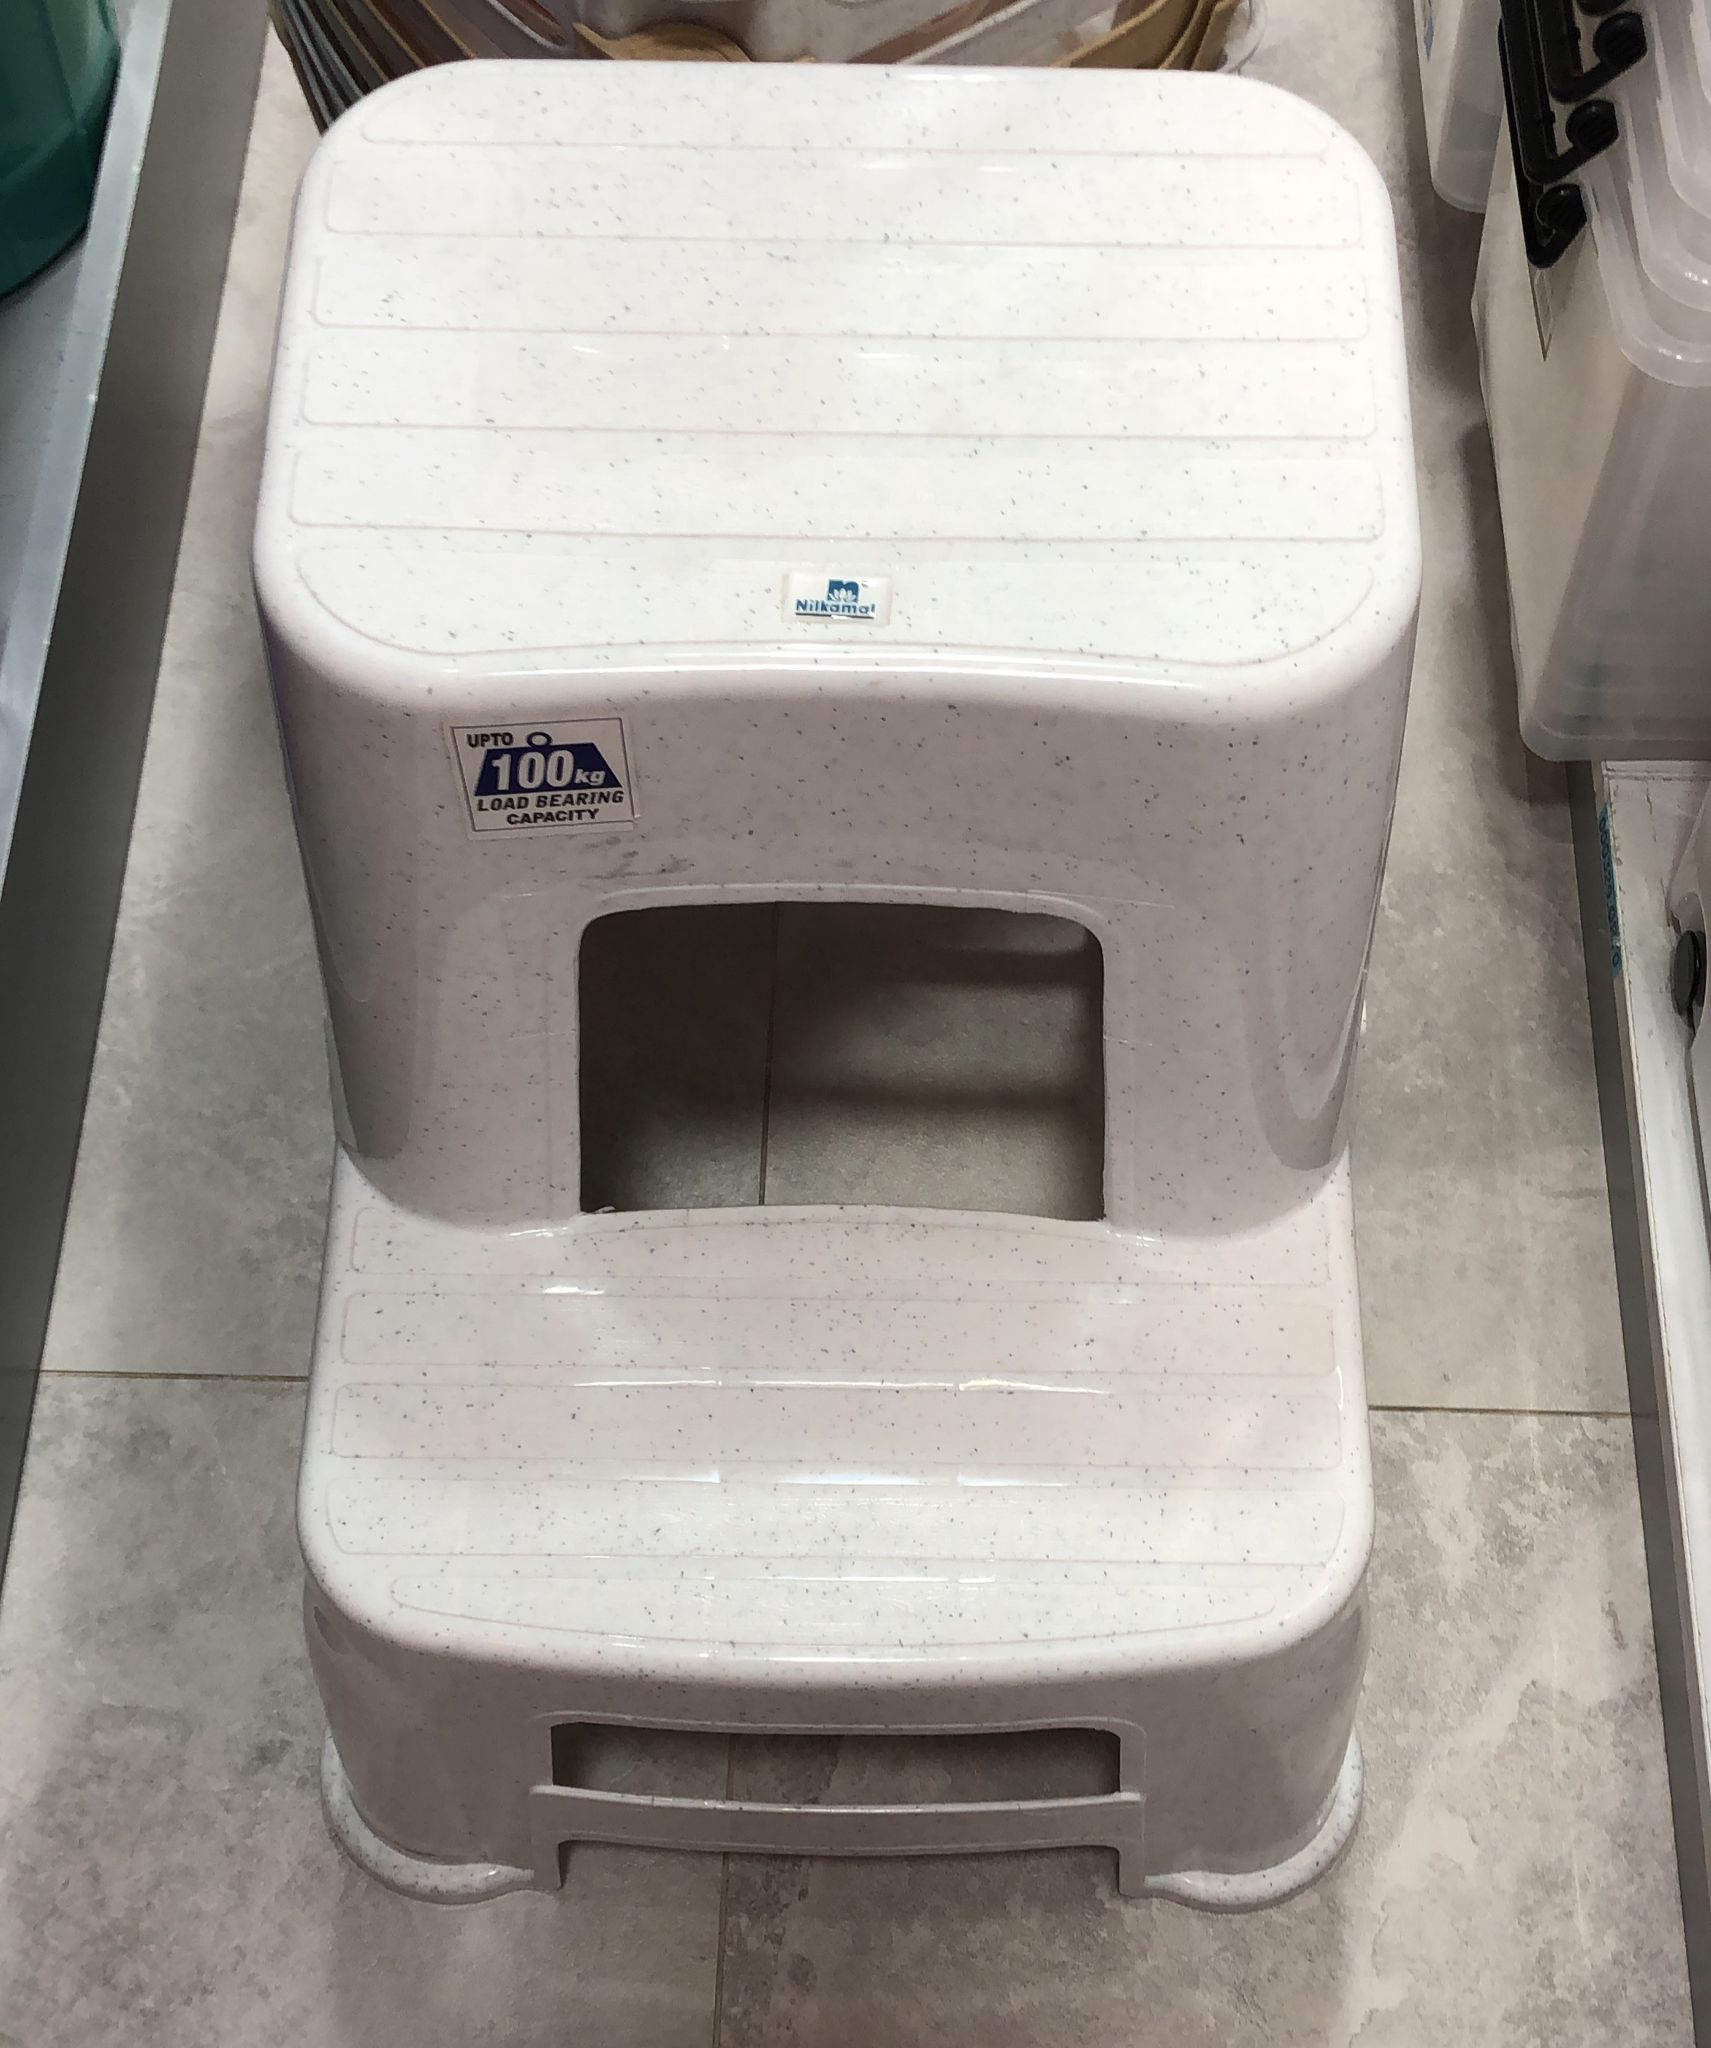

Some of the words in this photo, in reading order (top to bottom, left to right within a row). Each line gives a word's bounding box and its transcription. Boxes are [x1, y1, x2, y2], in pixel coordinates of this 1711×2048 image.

[795, 599, 876, 614] Nilkamal
[466, 732, 514, 748] UPTO
[477, 796, 529, 812] LOAD
[535, 790, 624, 808] BEARING
[506, 808, 600, 825] CAPACITY
